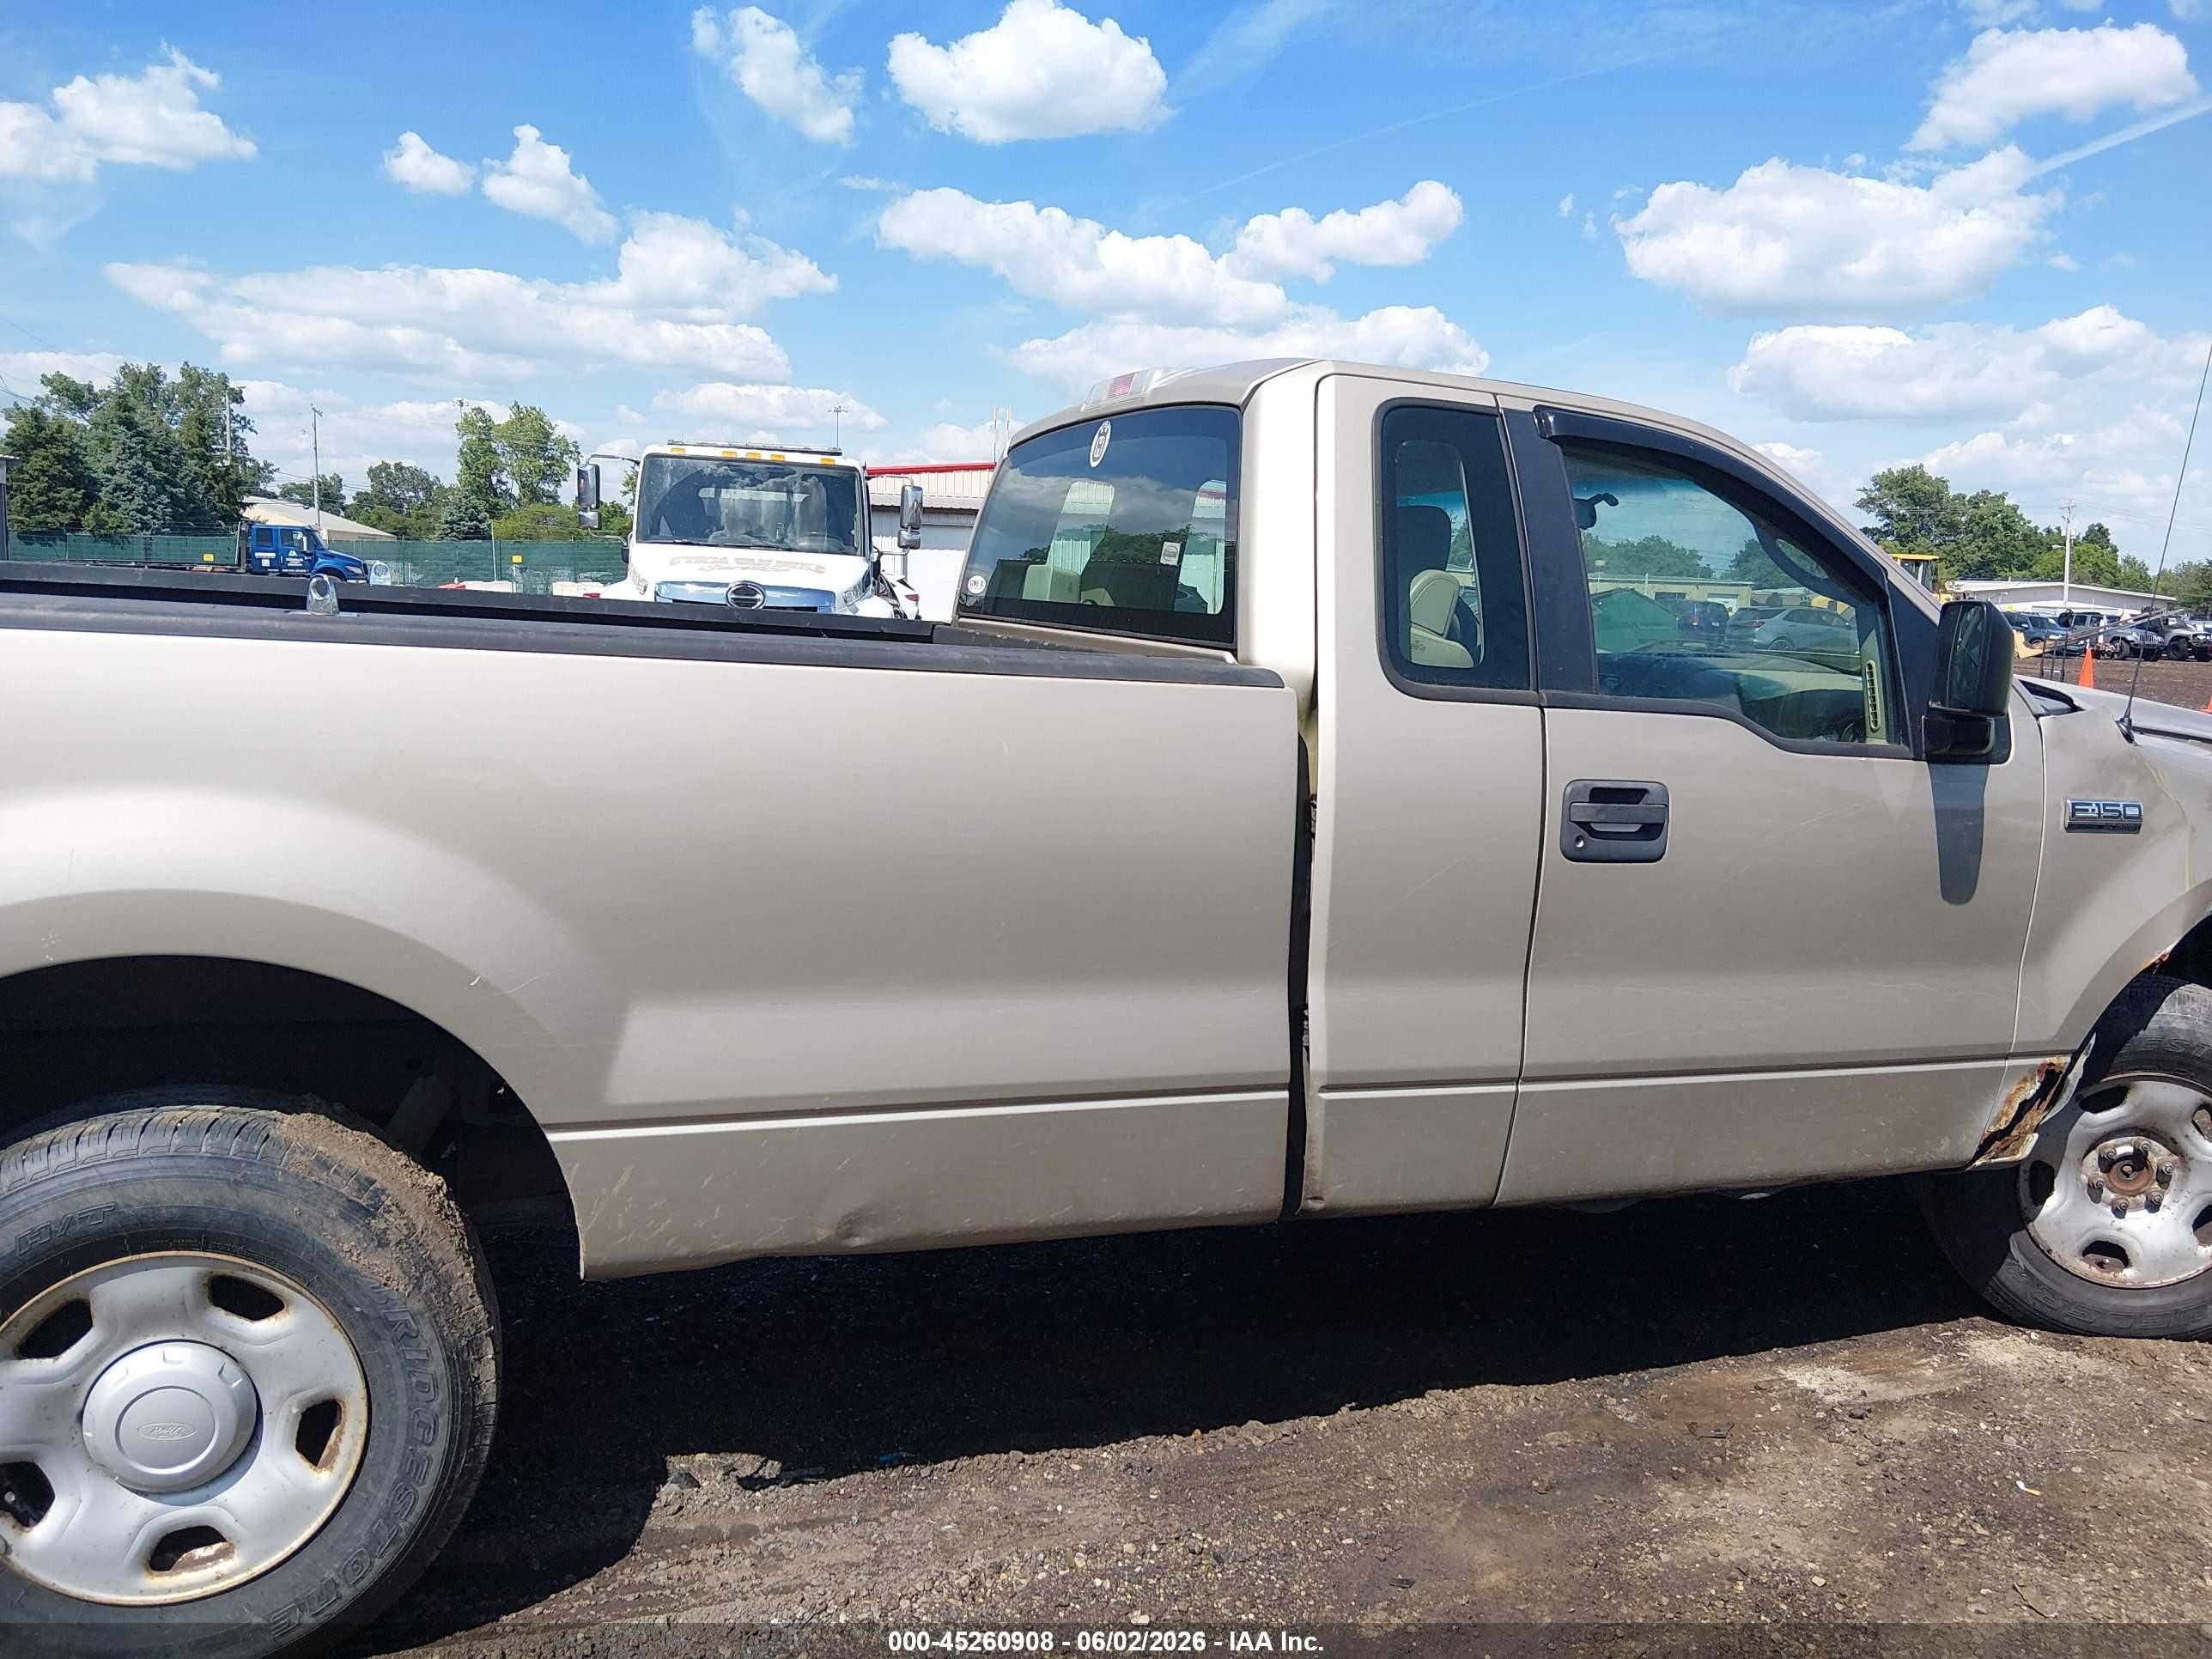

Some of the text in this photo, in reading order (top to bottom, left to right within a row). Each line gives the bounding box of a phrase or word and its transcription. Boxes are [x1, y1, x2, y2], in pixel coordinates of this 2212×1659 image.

[2070, 802, 2142, 820] F-150
[15, 1201, 117, 1257] H/T
[270, 1286, 441, 1644] RIDGESTONE
